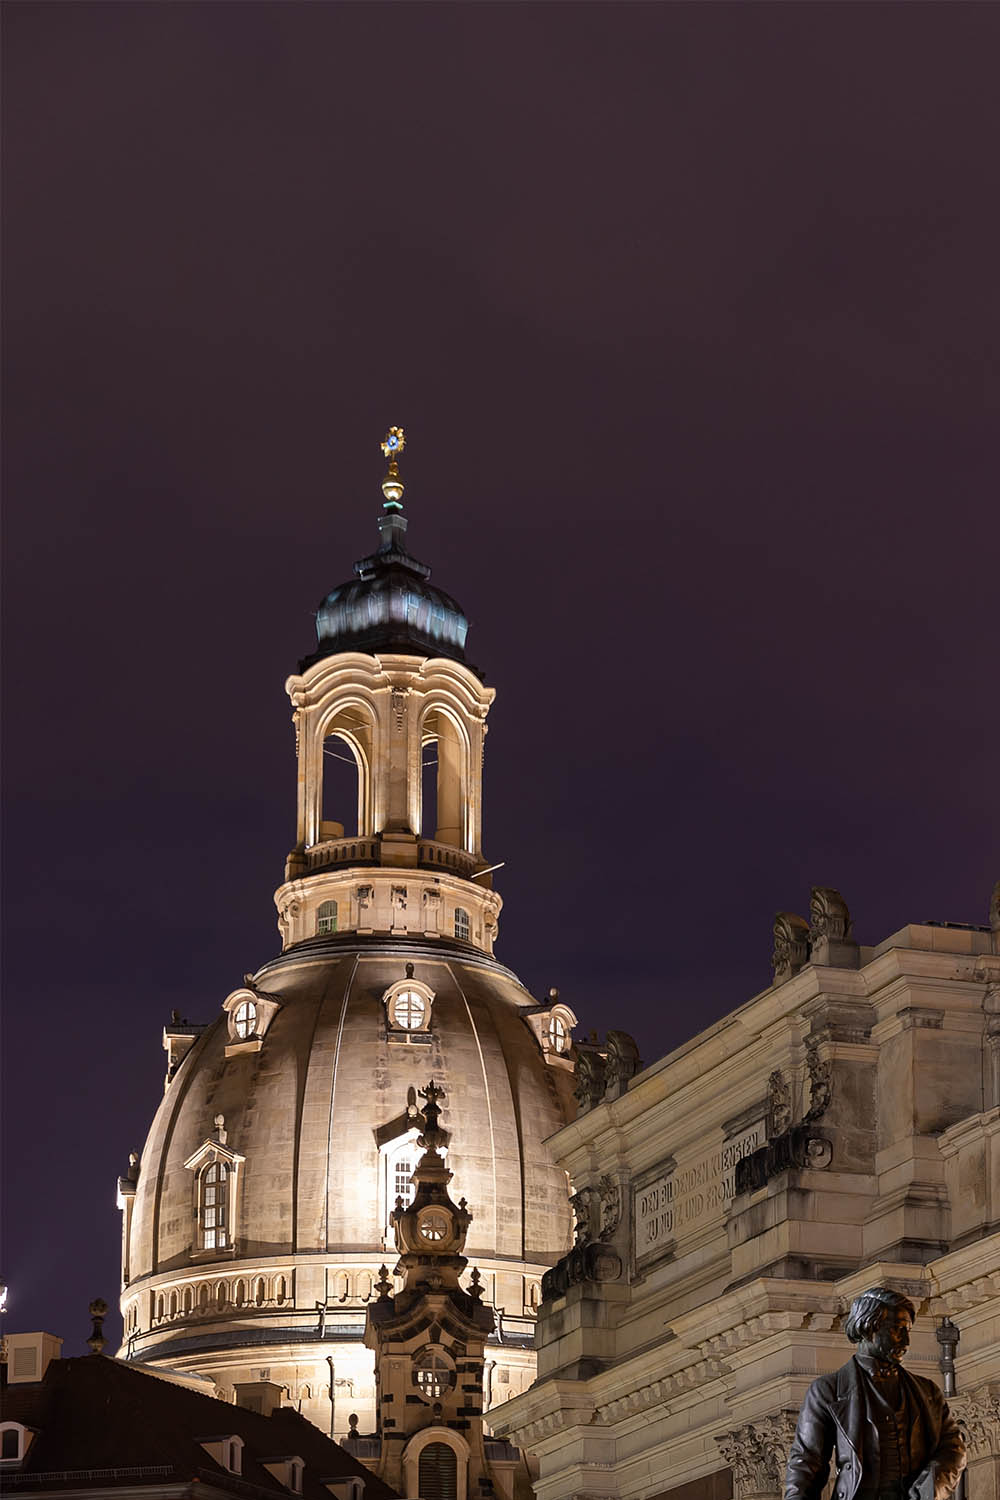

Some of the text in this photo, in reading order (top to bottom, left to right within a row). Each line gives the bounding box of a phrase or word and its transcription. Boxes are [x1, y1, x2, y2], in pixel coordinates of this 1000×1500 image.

[642, 1132, 759, 1217] DEN BILDENDEN KUENSTEN
[685, 1194, 704, 1223] UND
